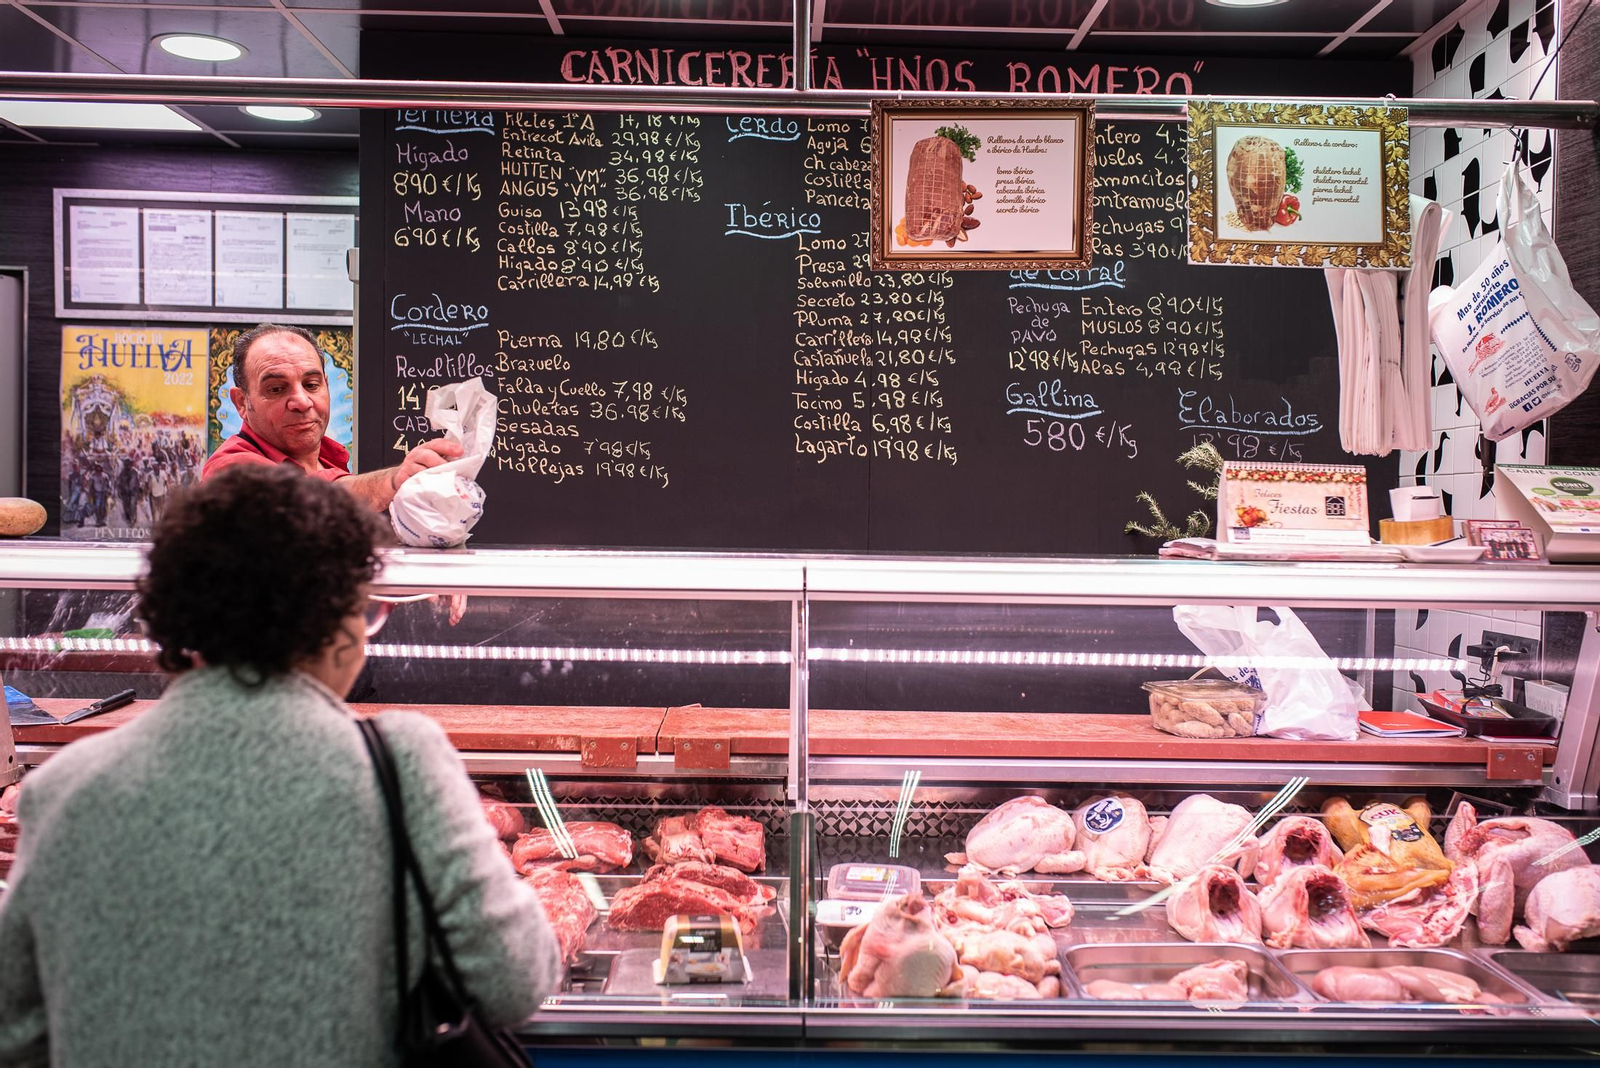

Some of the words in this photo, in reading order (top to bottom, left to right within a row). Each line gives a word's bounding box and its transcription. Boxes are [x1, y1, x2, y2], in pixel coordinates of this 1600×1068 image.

[807, 117, 851, 133] Lomo
[1094, 123, 1141, 145] ntero
[502, 127, 565, 145] Entrecot
[807, 135, 849, 155] Aguja
[986, 135, 1016, 144] Rellenos
[1017, 135, 1025, 144] de
[1026, 135, 1043, 144] cerdo
[1043, 135, 1064, 144] blanco
[1294, 138, 1322, 147] Rellenos
[1323, 139, 1331, 147] de
[1332, 139, 1358, 148] cordero:
[501, 141, 566, 163] Retinta
[991, 145, 1012, 154] ibérico
[1013, 145, 1021, 154] de
[501, 161, 562, 180] HUTTEN
[804, 154, 826, 170] Ch
[996, 166, 1012, 175] lomo
[1013, 166, 1034, 175] ibérico
[1312, 166, 1342, 175] chuletero
[1342, 166, 1361, 176] lechal
[804, 172, 871, 190] Costilla
[995, 179, 1014, 188] presa
[1015, 176, 1036, 185] ibérica
[1093, 167, 1186, 187] amoncitos
[1312, 175, 1342, 184] chuletero
[1342, 176, 1369, 185] recental
[499, 180, 559, 197] ANGUS
[996, 186, 1024, 194] cabezada
[1025, 186, 1045, 194] ibérica
[1312, 186, 1333, 196] pierna
[1334, 185, 1353, 194] lechal
[805, 189, 871, 210] Panceta
[996, 195, 1025, 204] solomillo
[1026, 195, 1046, 204] ibérico
[996, 205, 1018, 214] secreto
[1019, 204, 1040, 214] ibérico
[1312, 196, 1333, 205] pierna
[1334, 195, 1360, 204] recental
[404, 201, 462, 223] Mano
[498, 202, 542, 219] Guiso
[724, 201, 821, 229] Ibérico
[498, 219, 560, 238] Costilla
[1092, 215, 1165, 240] echugas
[497, 237, 556, 255] Callos
[797, 232, 847, 251] Lomo
[795, 254, 846, 275] Presa
[497, 271, 590, 291] Carrillera
[797, 271, 871, 289] Solomillo
[1457, 302, 1473, 321] Mas
[1472, 291, 1481, 303] de
[1480, 277, 1491, 292] 50
[1491, 259, 1510, 279] años
[391, 293, 489, 322] Cordero
[797, 292, 855, 308] Secreto
[1007, 296, 1071, 318] Pechuga
[1081, 296, 1143, 316] Entero
[1475, 278, 1520, 325] ROMERO
[793, 310, 853, 328] Pluma
[1031, 314, 1050, 328] de
[1082, 320, 1143, 335] MUSLOS
[497, 329, 563, 349] Pierna
[795, 329, 874, 347] Carrillera
[1011, 329, 1057, 344] PAVO
[75, 333, 193, 372] HUELVA
[793, 348, 874, 367] Castañuela
[1079, 339, 1157, 360] Pechugas
[396, 353, 495, 378] Revoltillos
[495, 351, 571, 372] Brazuelo
[1080, 359, 1126, 375] Alas
[163, 371, 194, 386] 2022
[1524, 366, 1550, 387] HUELVA
[1536, 379, 1549, 392] POR
[1547, 375, 1557, 384] SU
[497, 376, 544, 394] Falda
[560, 378, 607, 397] Cuello
[1006, 378, 1099, 409] Gallina
[497, 397, 579, 416] Chuletas
[792, 392, 842, 410] Tocino
[1177, 387, 1319, 428] Elaborados
[496, 417, 579, 437] Sesadas
[794, 411, 862, 432] Costilla
[795, 433, 868, 464] Lagarto
[1268, 499, 1318, 515] Fiestas
